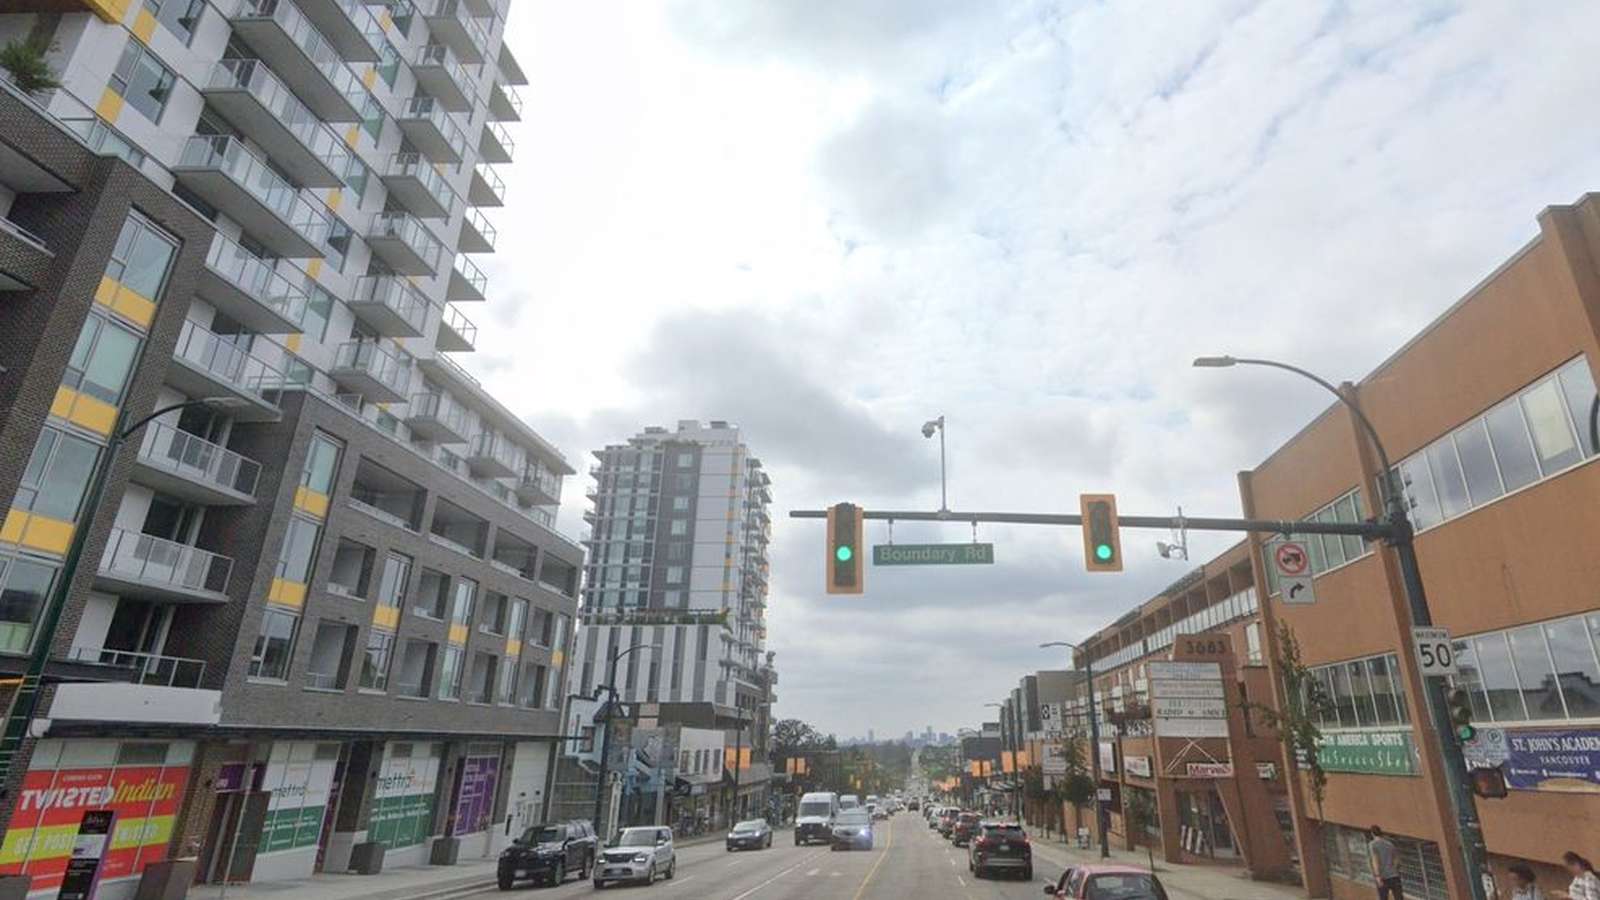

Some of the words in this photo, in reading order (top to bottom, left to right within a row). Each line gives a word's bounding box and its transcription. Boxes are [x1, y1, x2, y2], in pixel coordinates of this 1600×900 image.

[880, 545, 957, 562] Boundary
[966, 544, 986, 560] Rd
[1415, 630, 1447, 639] MAXIMUM
[1419, 643, 1451, 668] 50
[1371, 734, 1404, 746] SPORTS
[1527, 737, 1561, 753] JOHN'S
[1539, 755, 1592, 765] VANCOUVER
[21, 786, 115, 811] TWISTED
[113, 777, 176, 804] Indian
